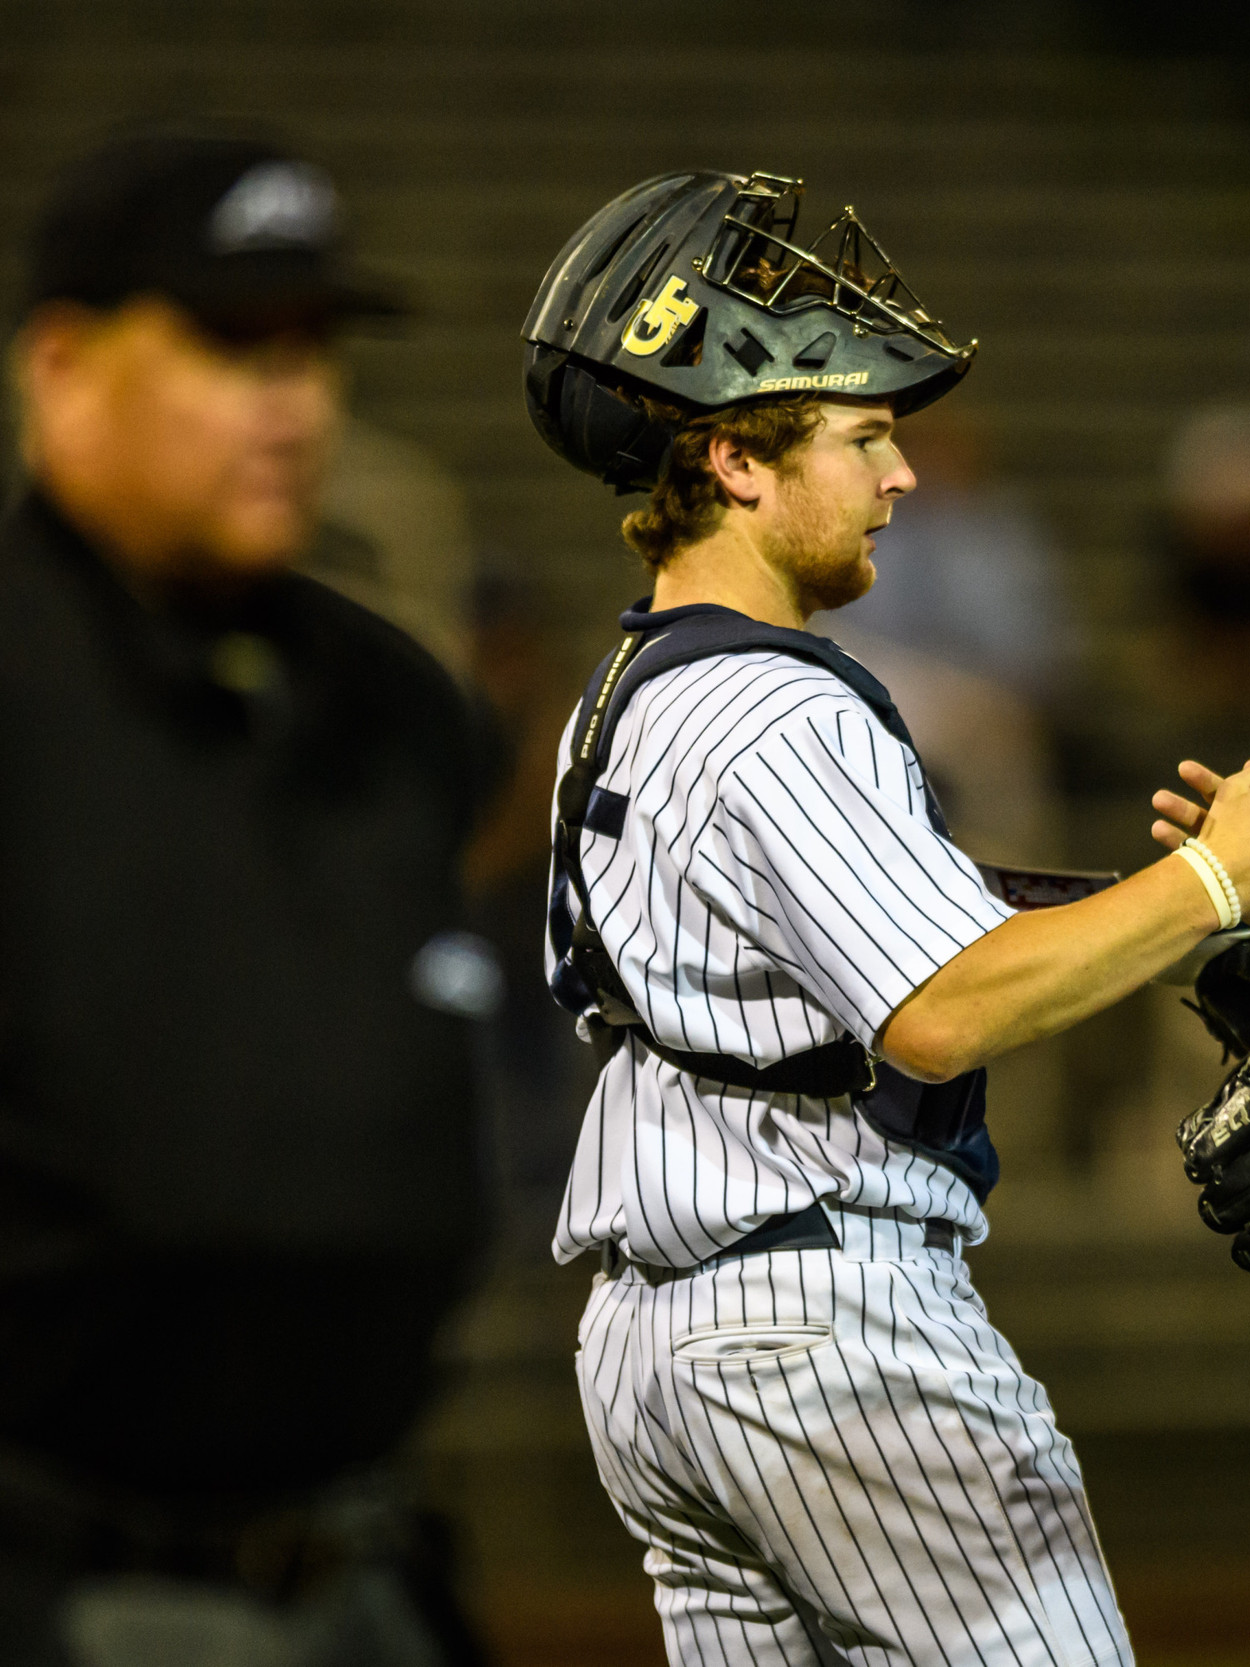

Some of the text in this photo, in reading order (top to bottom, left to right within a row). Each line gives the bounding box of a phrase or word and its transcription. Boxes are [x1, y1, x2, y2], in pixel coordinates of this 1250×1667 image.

[621, 275, 700, 355] GT
[757, 371, 869, 392] SAMURAI
[581, 637, 632, 759] PRO SERIES
